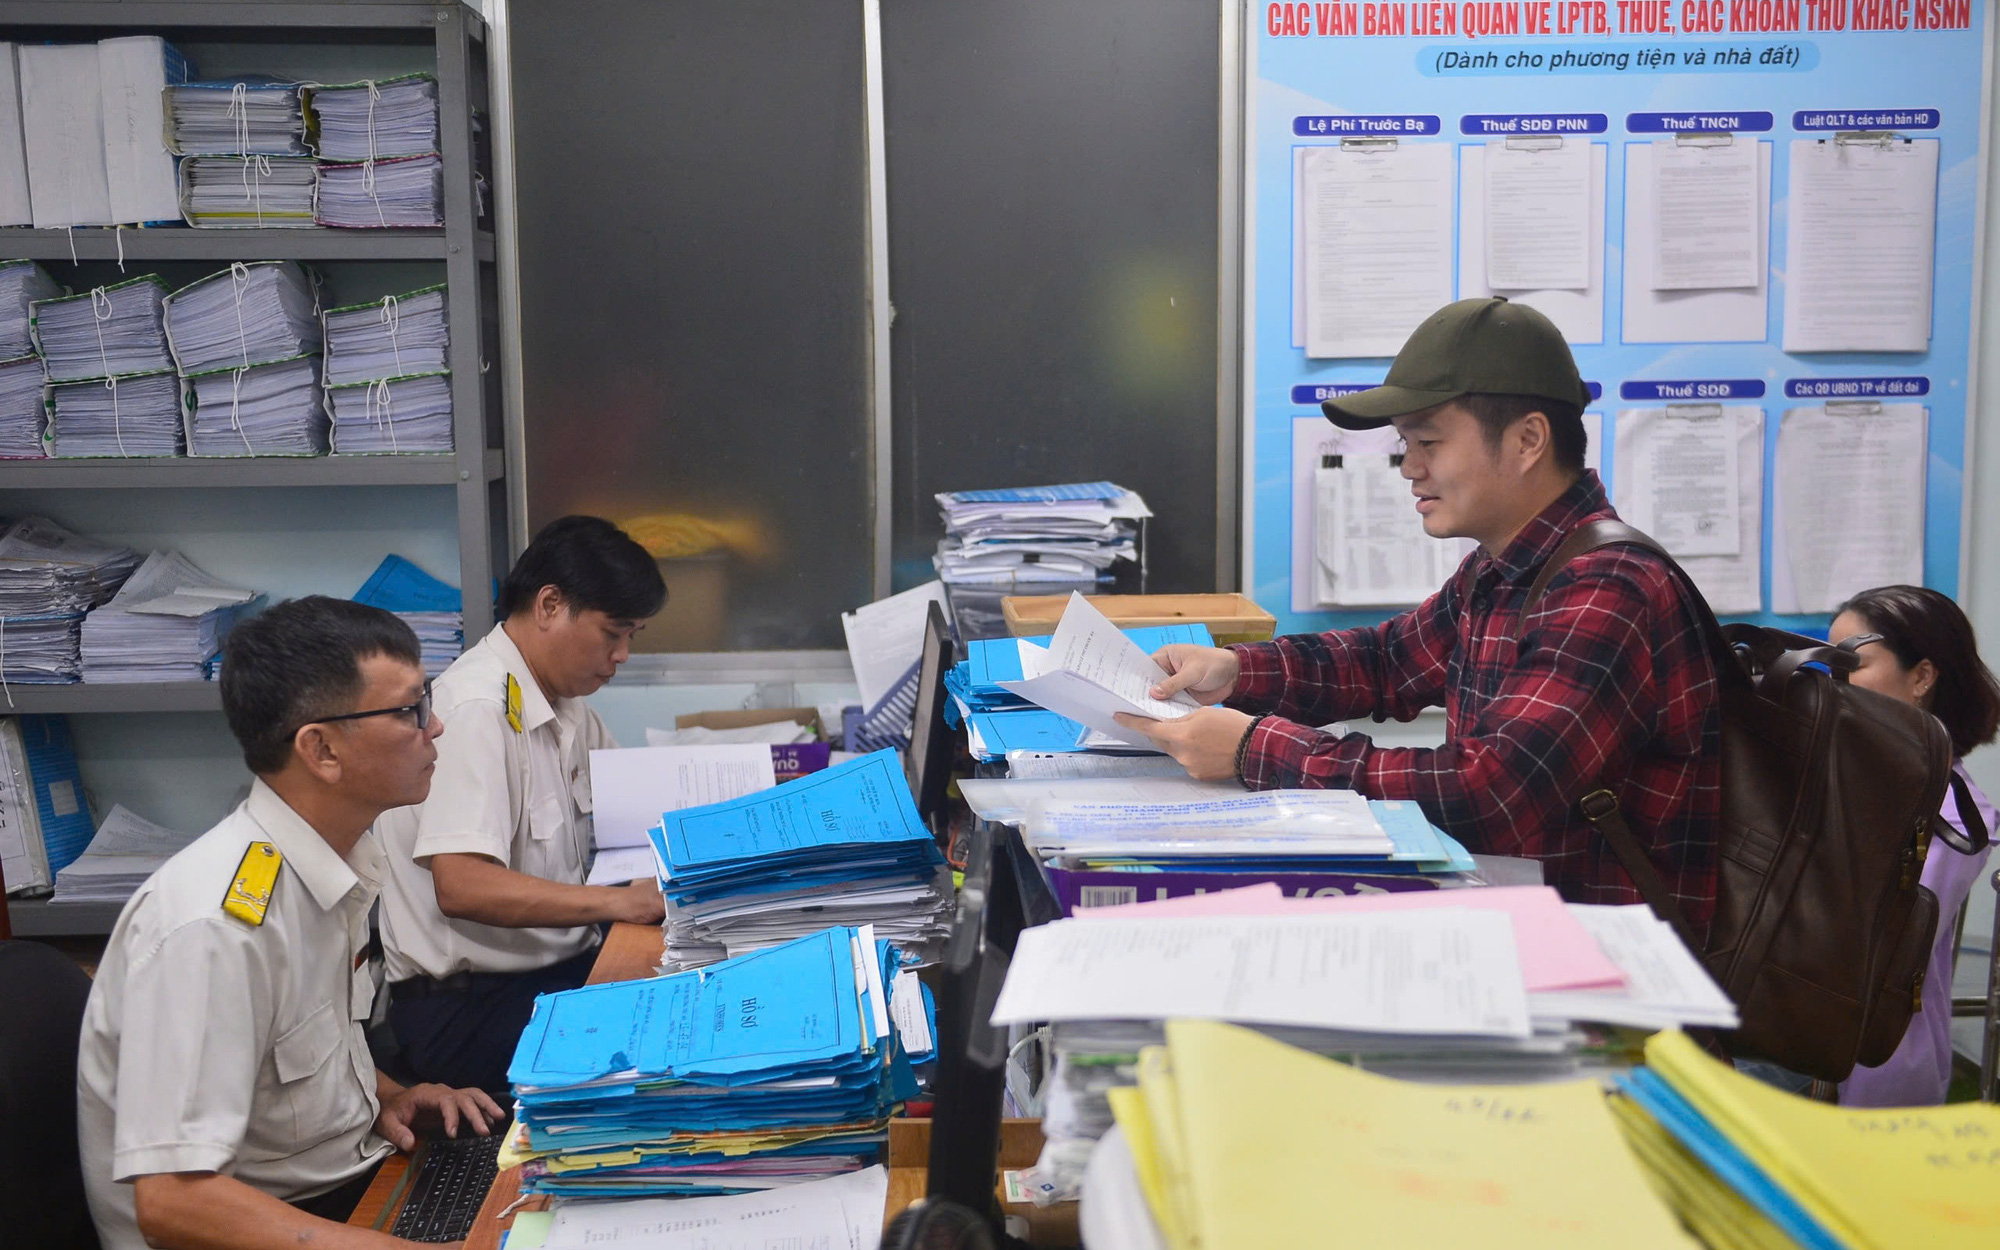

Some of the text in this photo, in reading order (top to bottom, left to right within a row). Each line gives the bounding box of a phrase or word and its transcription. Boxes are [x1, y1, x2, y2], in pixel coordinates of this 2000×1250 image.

[1462, 2, 1518, 38] QUAN
[1557, 1, 1611, 36] LPTB,
[1805, 0, 1846, 31] THU
[1914, 0, 1970, 29] NSNN
[1435, 45, 1799, 73] (Dành cho phương tiện và nhà đất)
[1308, 119, 1424, 133] Lệ Phí Trước Bạ
[1481, 118, 1588, 131] Thuế SDĐ PNN
[1662, 115, 1739, 129] Thuế TNCN
[1803, 112, 1929, 128] Luật QLT & các văn bản HD
[1656, 383, 1730, 397] Thuế SDĐ
[1795, 380, 1919, 395] Các QĐ UBND TP về đất đai
[820, 809, 841, 832] HỒ SƠ
[740, 997, 765, 1028] HỒ SƠ
